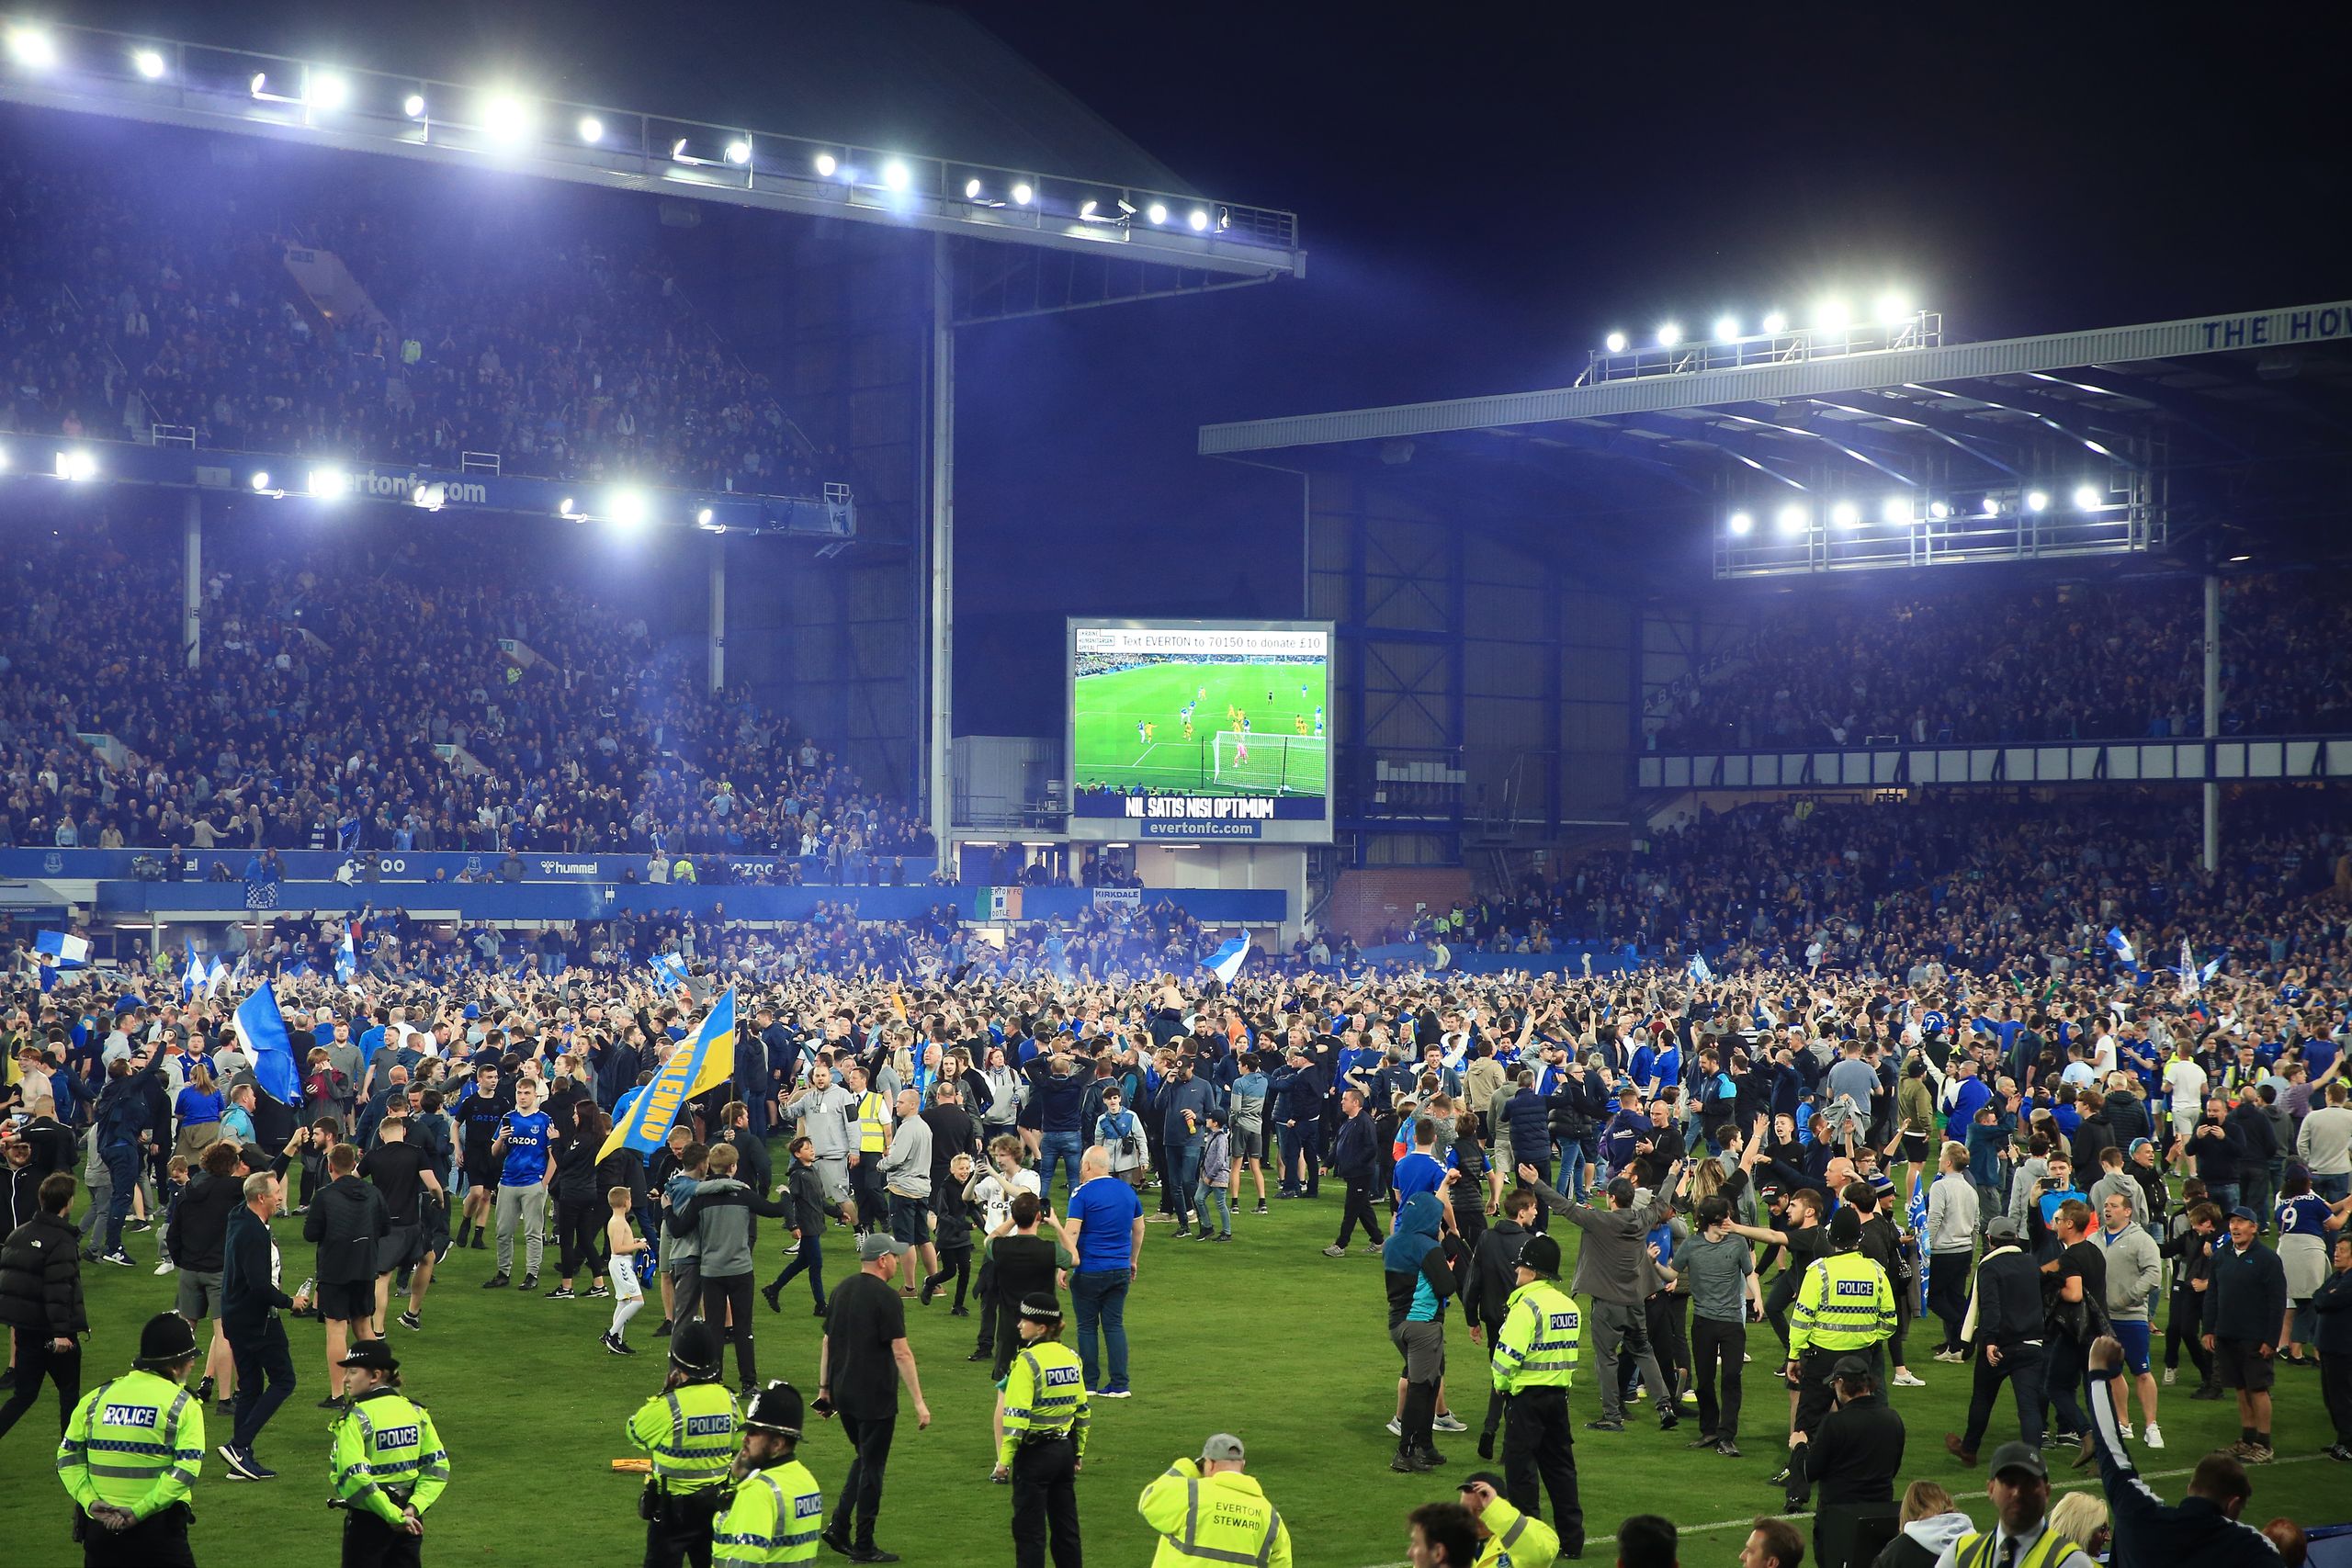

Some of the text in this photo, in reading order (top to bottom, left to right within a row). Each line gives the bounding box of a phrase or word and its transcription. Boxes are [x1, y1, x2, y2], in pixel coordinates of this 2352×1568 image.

[2203, 316, 2268, 348] THE
[1123, 636, 1321, 649] Text EVERTON to 70150 to donate £10
[1125, 796, 1274, 819] NIL SATIS NISI OPTIMUM
[1150, 821, 1253, 835] evertonfc.com
[556, 861, 597, 874] hummel
[1095, 890, 1139, 898] KIRKDALE
[1927, 1019, 1936, 1031] 7
[471, 1114, 500, 1122] CAZOO
[507, 1137, 538, 1146] CAZOO
[2281, 1206, 2298, 1232] 9
[1838, 1281, 1872, 1294] POLICE
[1550, 1314, 1577, 1329] POLICE
[1046, 1368, 1080, 1385] POLICE
[103, 1405, 155, 1426] POLICE
[689, 1416, 730, 1434] POLICE
[378, 1427, 418, 1449] POLICE
[1216, 1502, 1261, 1517] EVERTON
[1213, 1515, 1260, 1531] STEWARD
